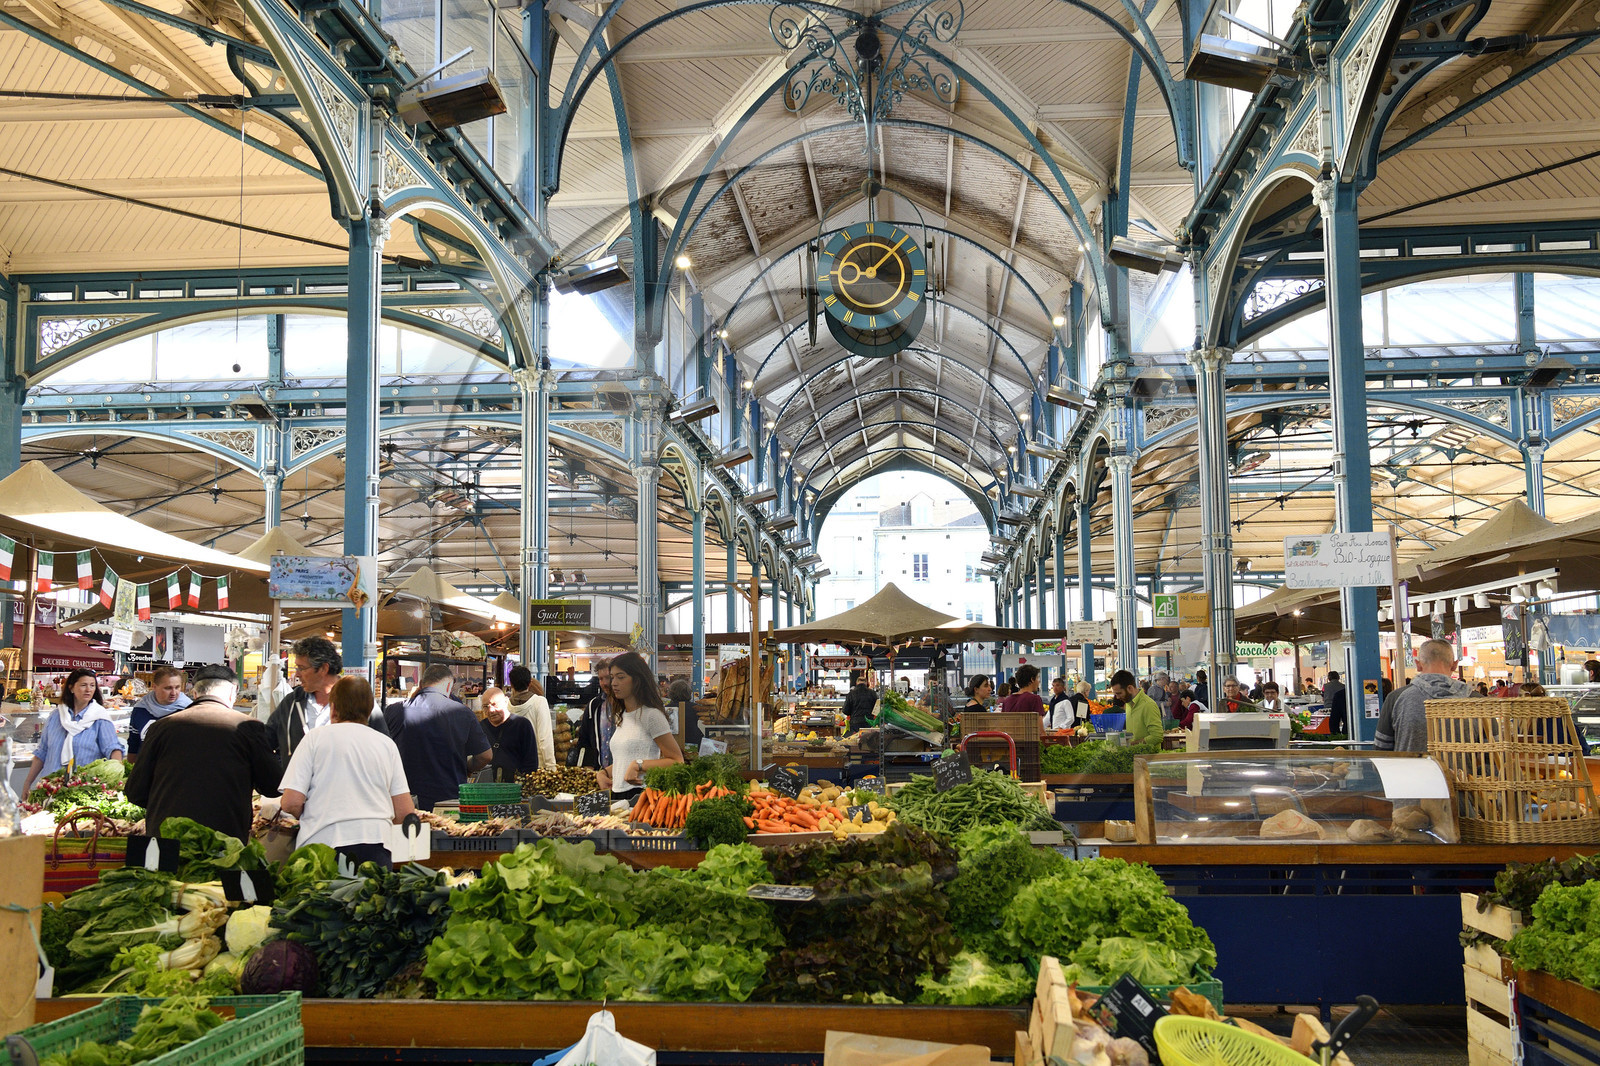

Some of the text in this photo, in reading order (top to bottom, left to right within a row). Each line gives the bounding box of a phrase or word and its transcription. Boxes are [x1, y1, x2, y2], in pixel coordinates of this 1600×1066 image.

[42, 657, 104, 668] BOUCHERIE CHARCUTERIE
[1134, 998, 1148, 1014] AIL
